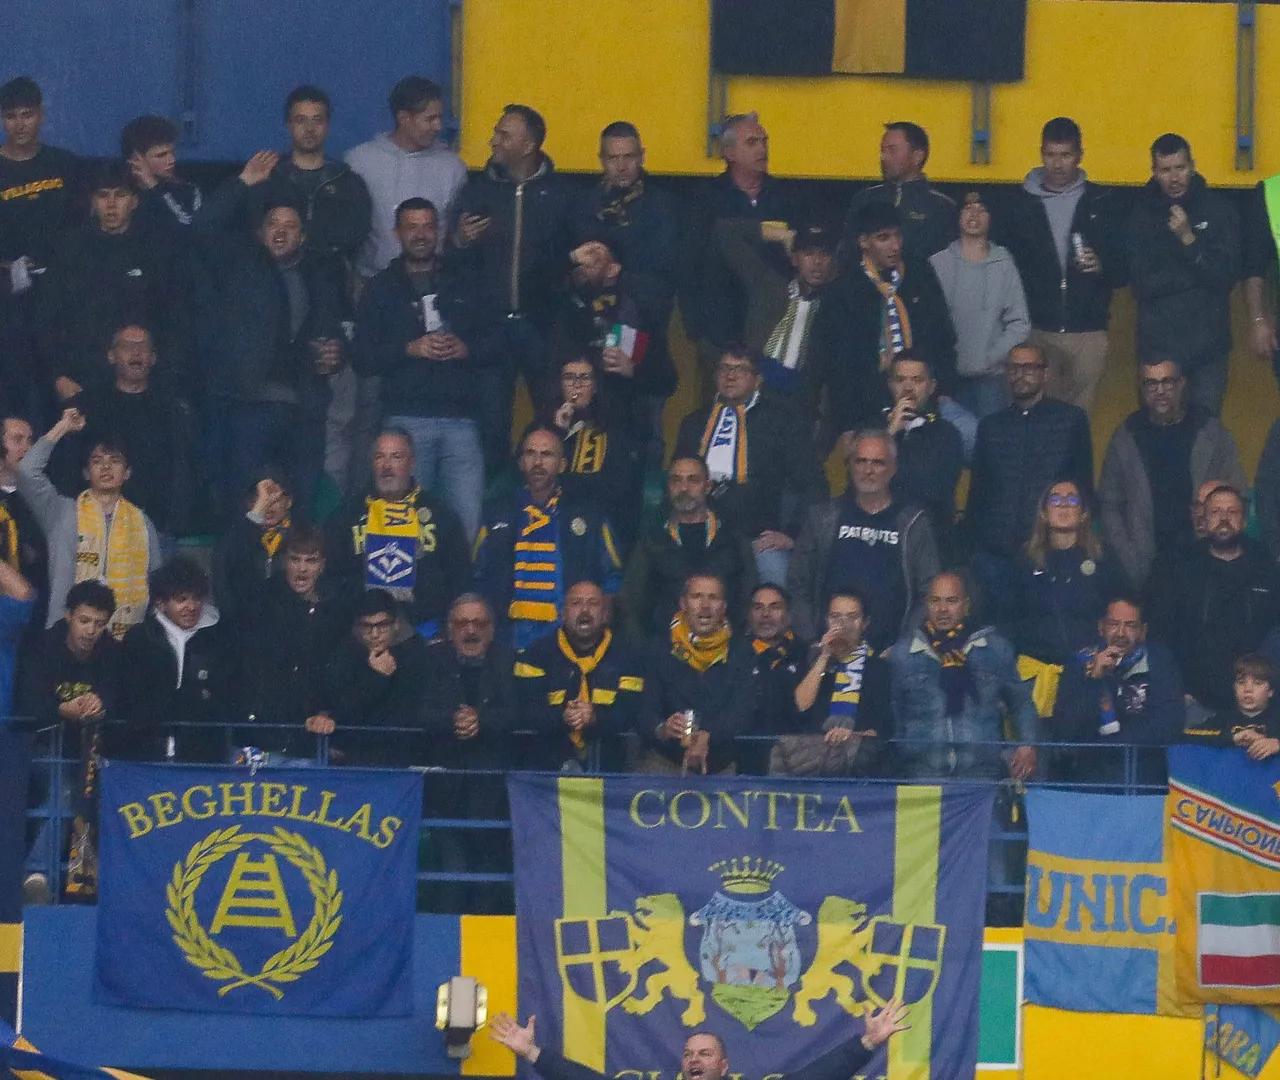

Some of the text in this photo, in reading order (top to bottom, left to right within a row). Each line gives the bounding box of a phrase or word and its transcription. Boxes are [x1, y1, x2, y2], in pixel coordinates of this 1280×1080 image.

[119, 780, 403, 850] BEGHELLAS
[629, 789, 865, 834] CONTEA
[1027, 866, 1178, 935] UNIC
